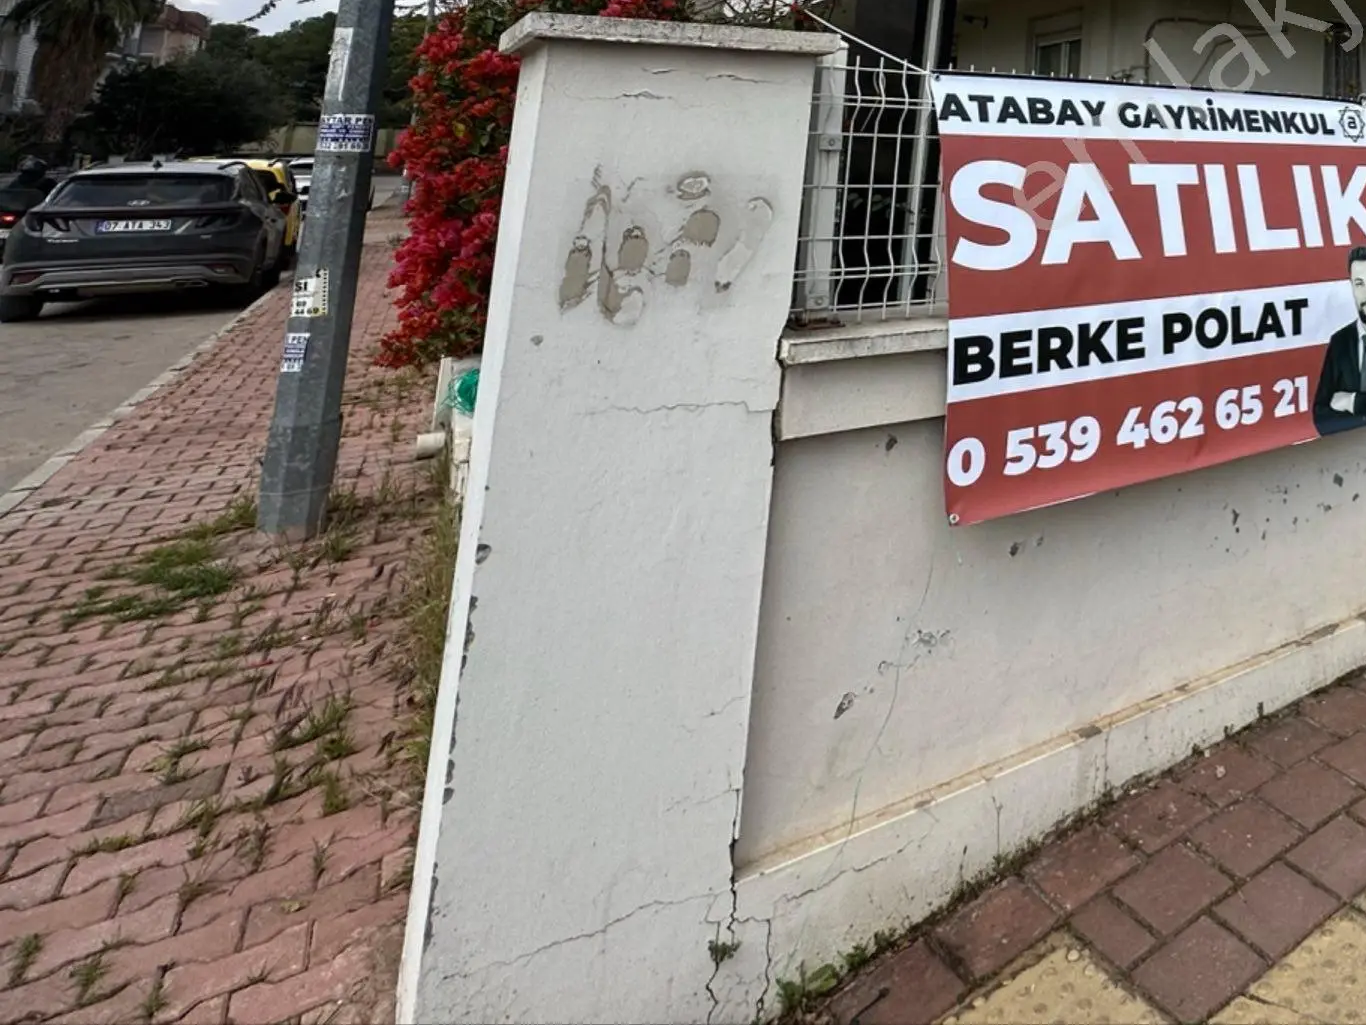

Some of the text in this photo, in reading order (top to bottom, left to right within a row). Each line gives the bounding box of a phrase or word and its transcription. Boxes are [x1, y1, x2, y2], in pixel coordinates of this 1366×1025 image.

[939, 92, 1106, 127] ATABAY
[1117, 98, 1336, 137] GAYRİMENKUL
[953, 298, 1310, 387] BERKE POLAT
[947, 376, 1309, 487] 0 539 462 65 21
